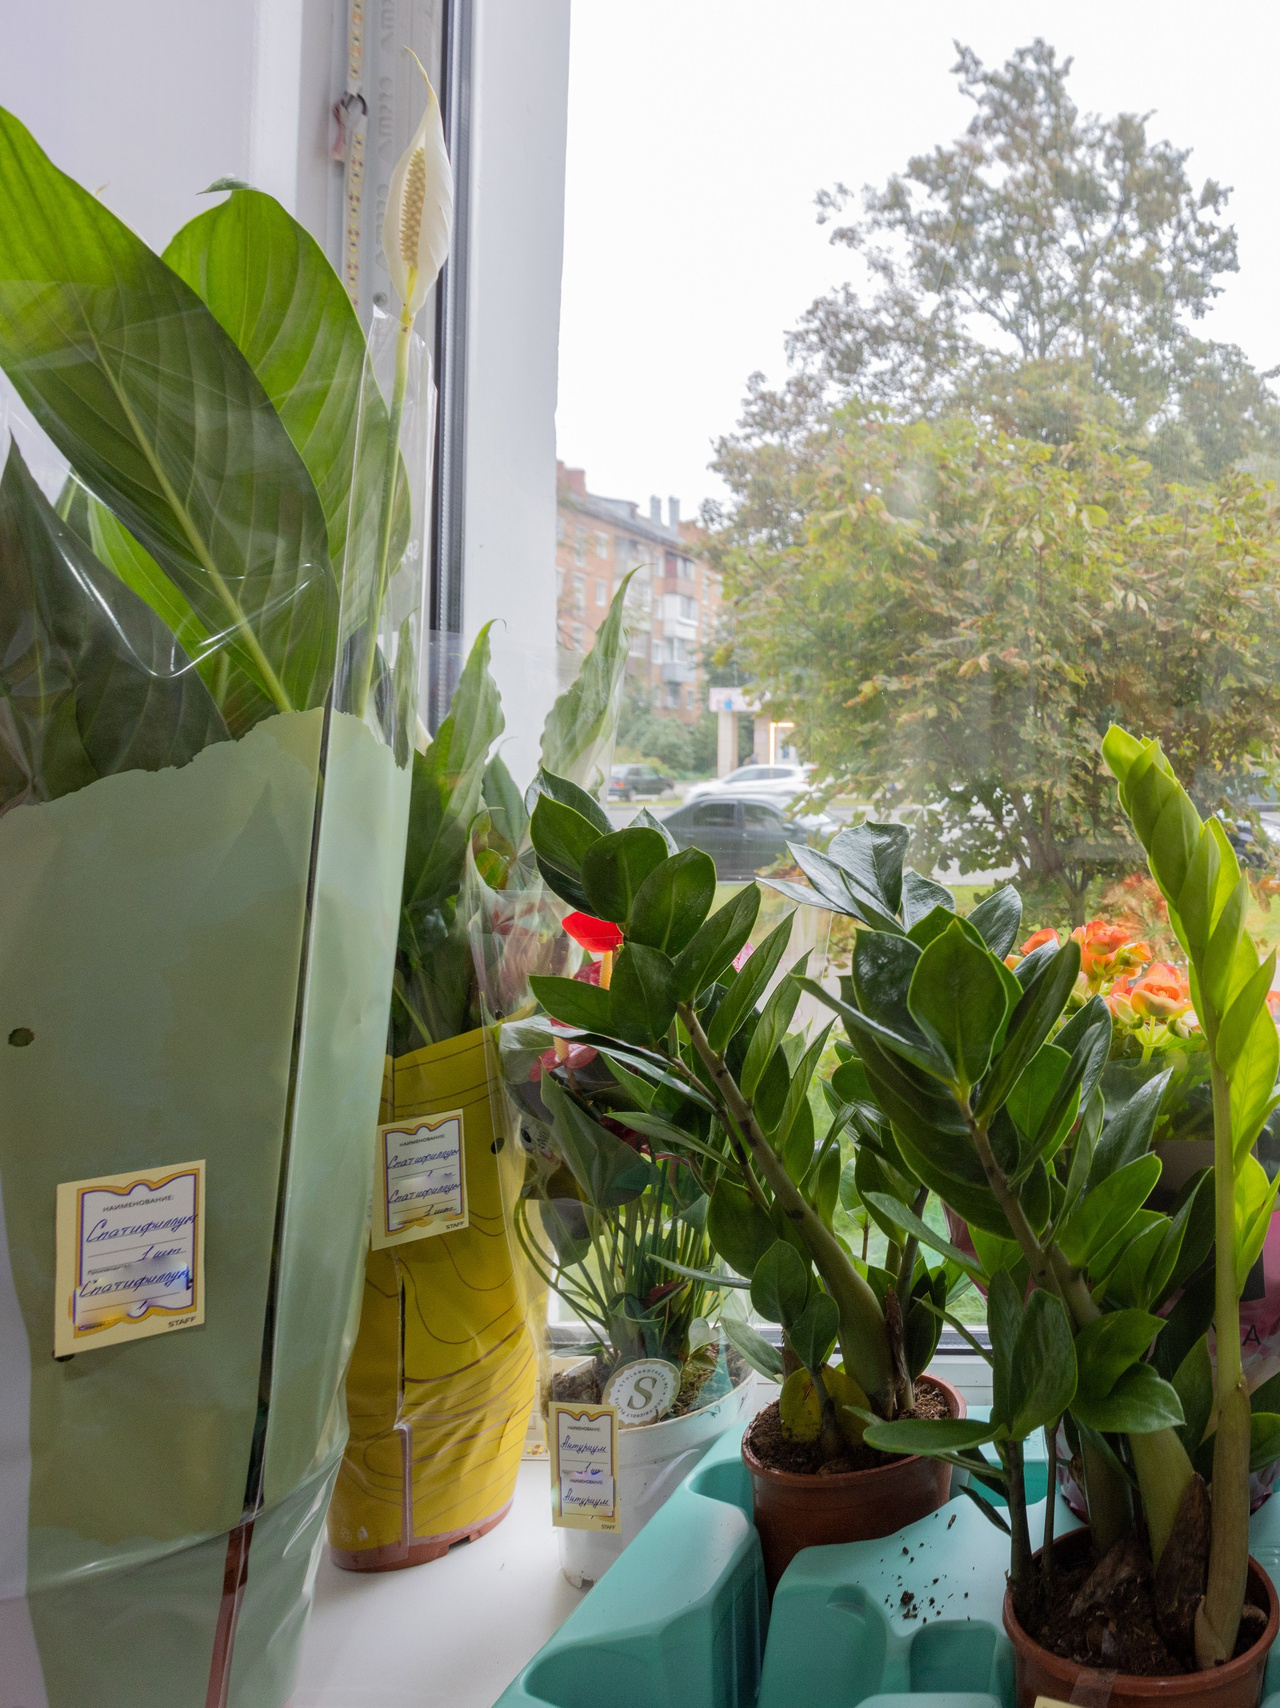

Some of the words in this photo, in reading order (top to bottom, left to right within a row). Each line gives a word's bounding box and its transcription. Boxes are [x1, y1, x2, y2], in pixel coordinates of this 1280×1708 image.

[102, 1194, 175, 1212] НАИМЕНОВАНИЕ:
[445, 1221, 465, 1230] STAFF
[168, 1316, 197, 1328] STAFF
[627, 1376, 657, 1410] S
[560, 1434, 608, 1454] Антуриум
[563, 1487, 611, 1507] Антуриум
